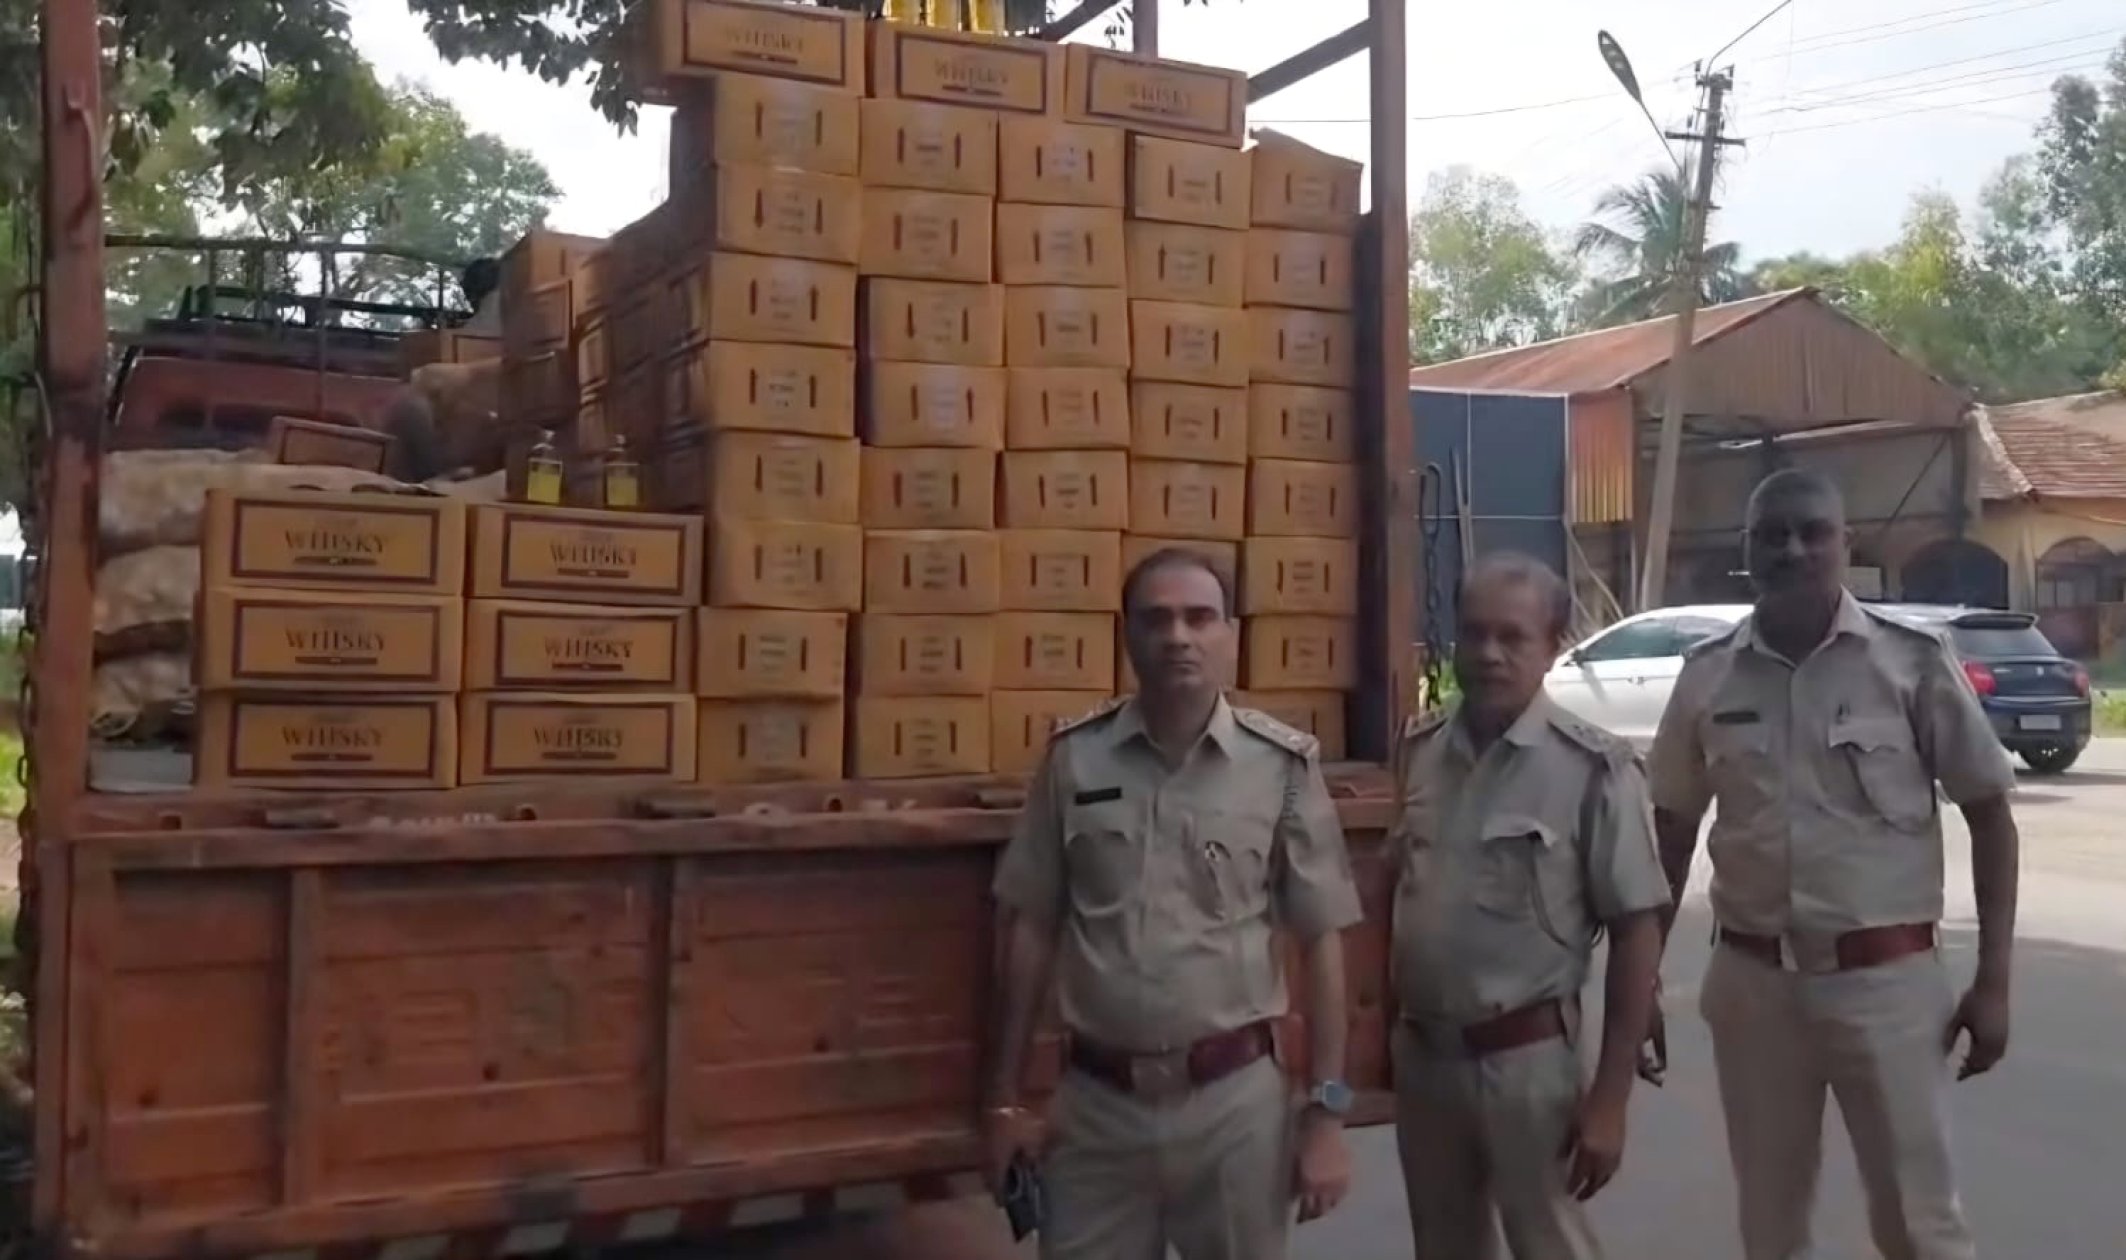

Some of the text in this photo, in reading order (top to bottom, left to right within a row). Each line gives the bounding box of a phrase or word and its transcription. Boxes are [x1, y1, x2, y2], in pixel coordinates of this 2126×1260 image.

[284, 529, 386, 554] WHISKY
[285, 627, 386, 652] WHISKY
[544, 636, 634, 660] WHISKY
[281, 726, 383, 748] WHISKY
[533, 726, 624, 750] WHISKY
